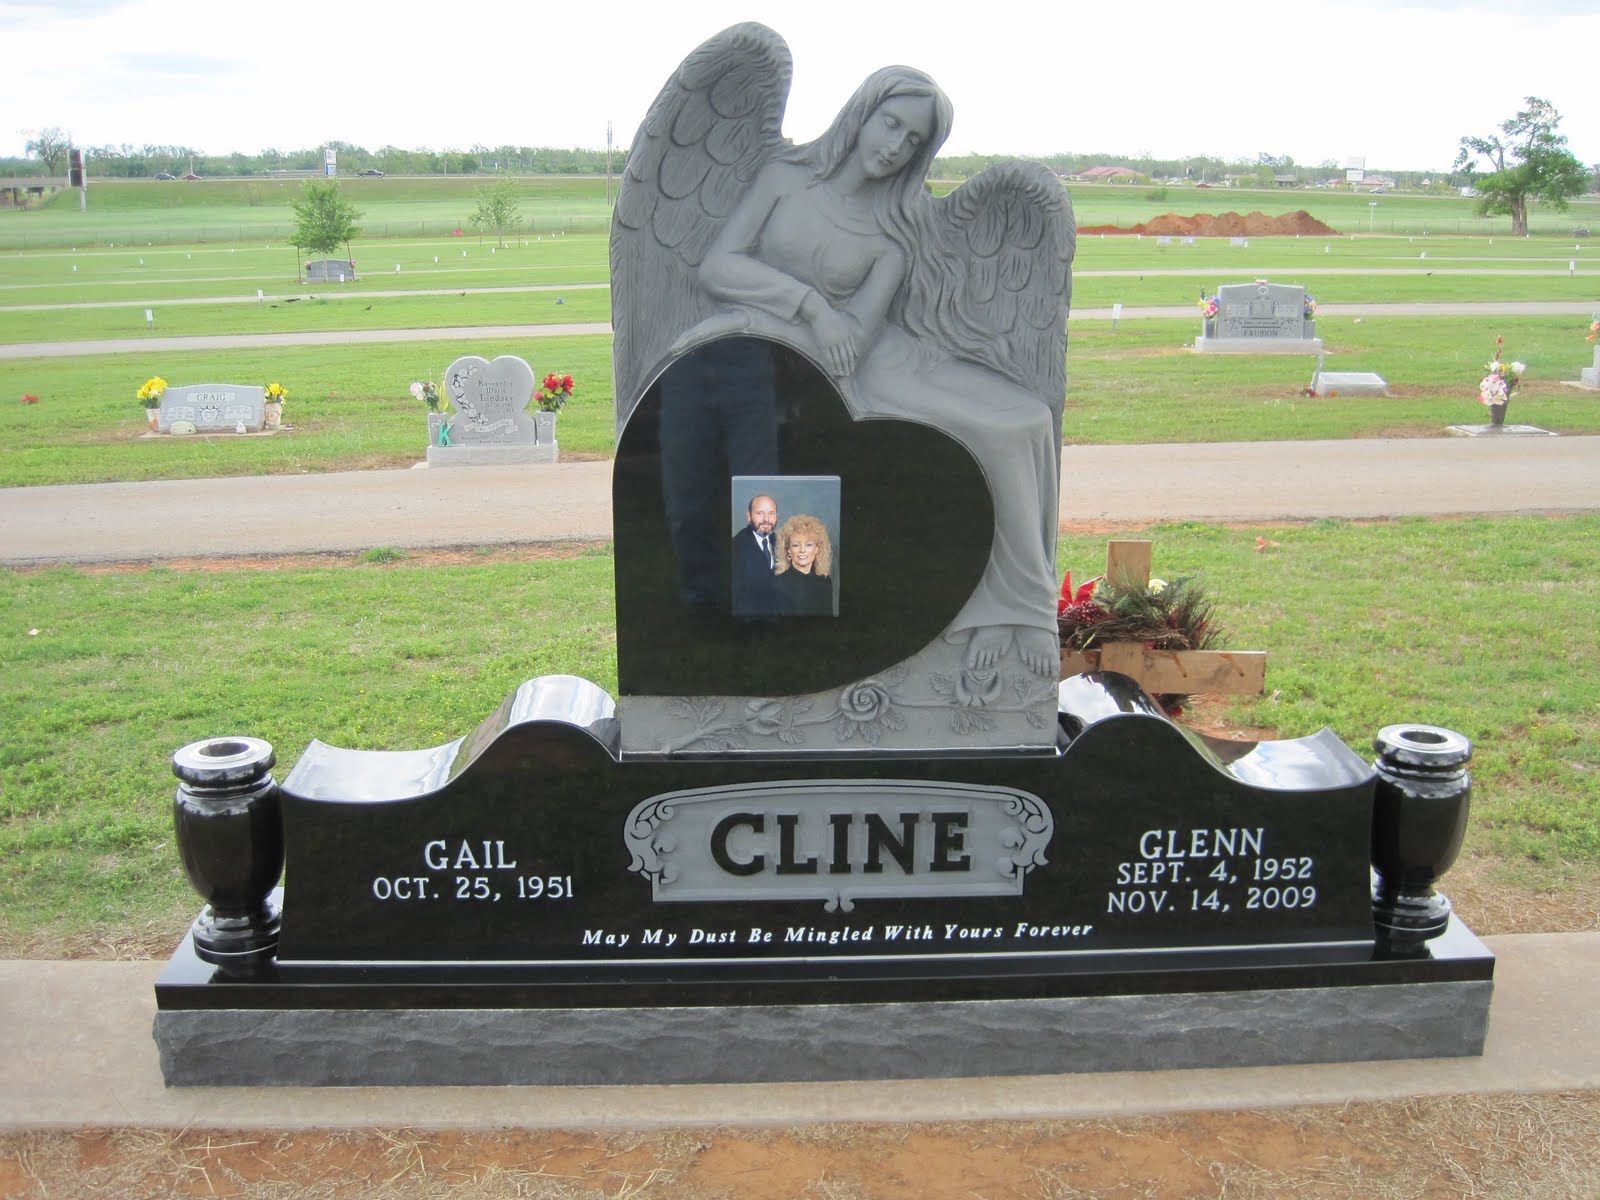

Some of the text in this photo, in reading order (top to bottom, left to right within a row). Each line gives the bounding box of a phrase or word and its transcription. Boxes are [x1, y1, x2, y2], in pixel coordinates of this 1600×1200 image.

[196, 393, 226, 401] CRAIG
[424, 839, 517, 870] GAIL
[710, 811, 971, 876] CLINE
[1139, 828, 1265, 859] GLENN
[1117, 857, 1313, 885] SEPT. 4, 1952
[373, 875, 574, 902] OCT. 25, 1951
[1107, 886, 1317, 913] NOV. 14, 2009
[582, 922, 1093, 947] May My Dust Be Mingled With Yours Forever
